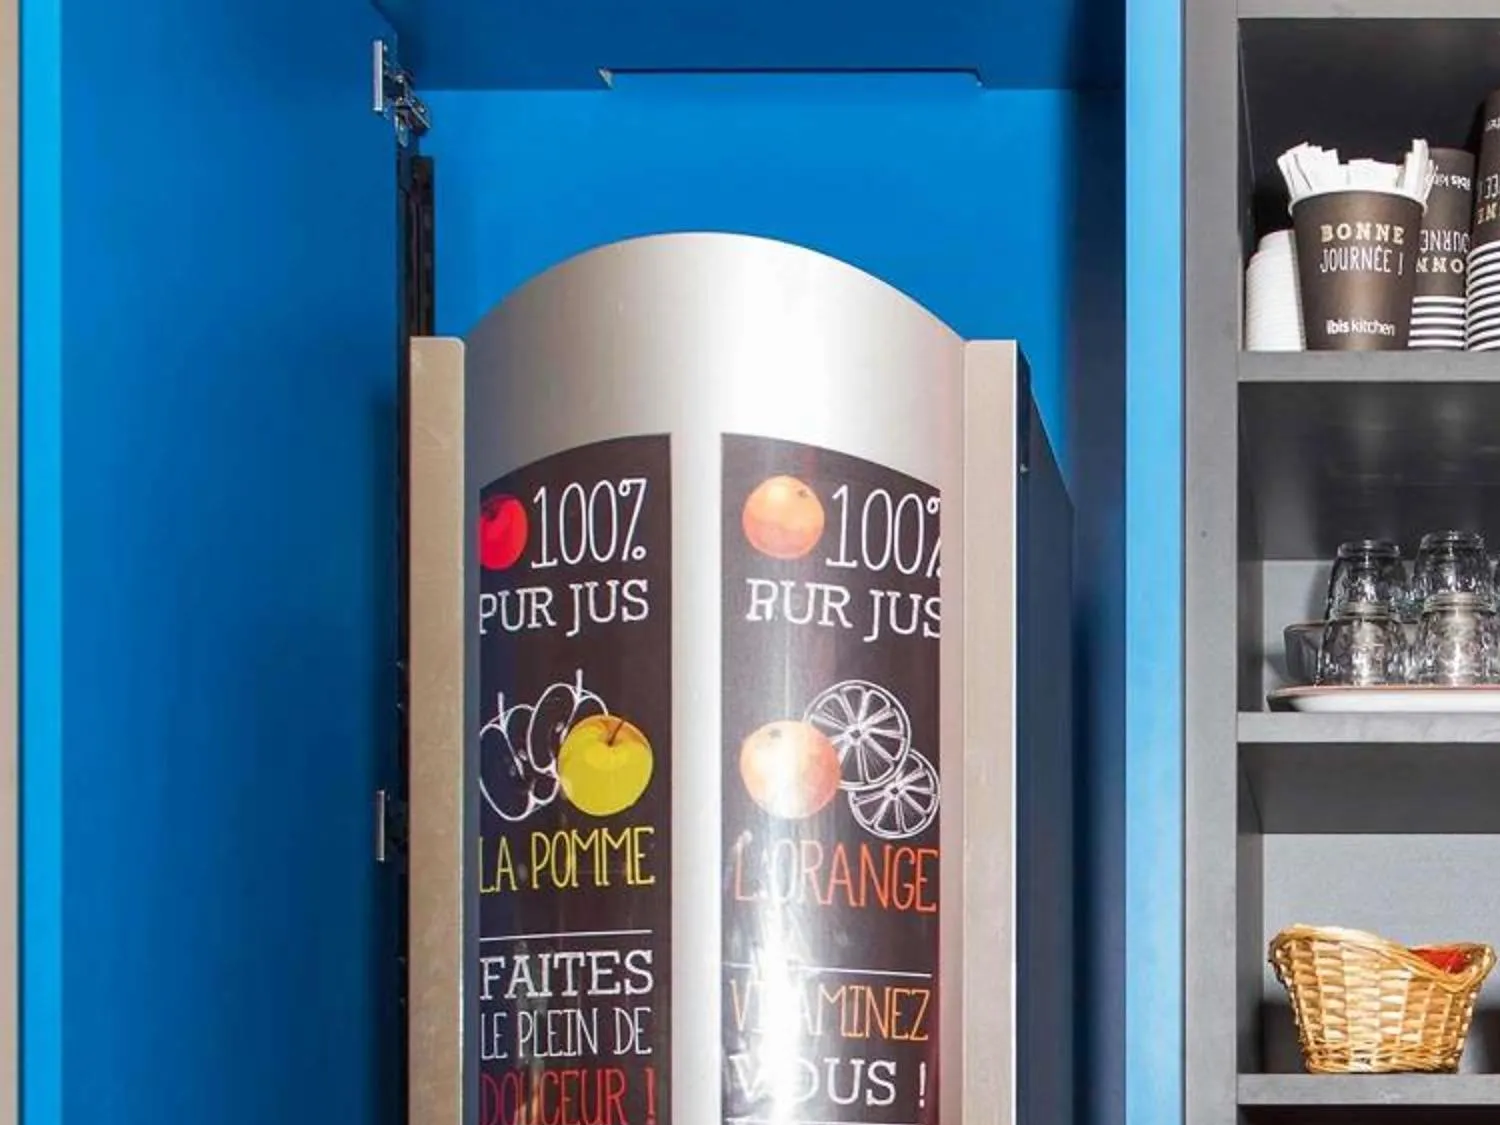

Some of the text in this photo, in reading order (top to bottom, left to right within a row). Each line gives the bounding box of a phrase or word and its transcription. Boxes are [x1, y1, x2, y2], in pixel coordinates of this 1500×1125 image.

[1319, 220, 1405, 246] BONNE
[1319, 244, 1393, 273] JOURNÉE
[1416, 256, 1464, 274] ONN
[1351, 317, 1395, 337] kitchen
[531, 477, 648, 570] 100%
[480, 578, 650, 638] PUR JUS
[863, 588, 941, 643] JUS
[480, 826, 656, 893] LA POMME
[480, 948, 654, 1001] FAITES
[480, 1006, 653, 1060] LE PLEIN DE
[730, 978, 931, 1041] VAMINEZ
[918, 1061, 928, 1109] !
